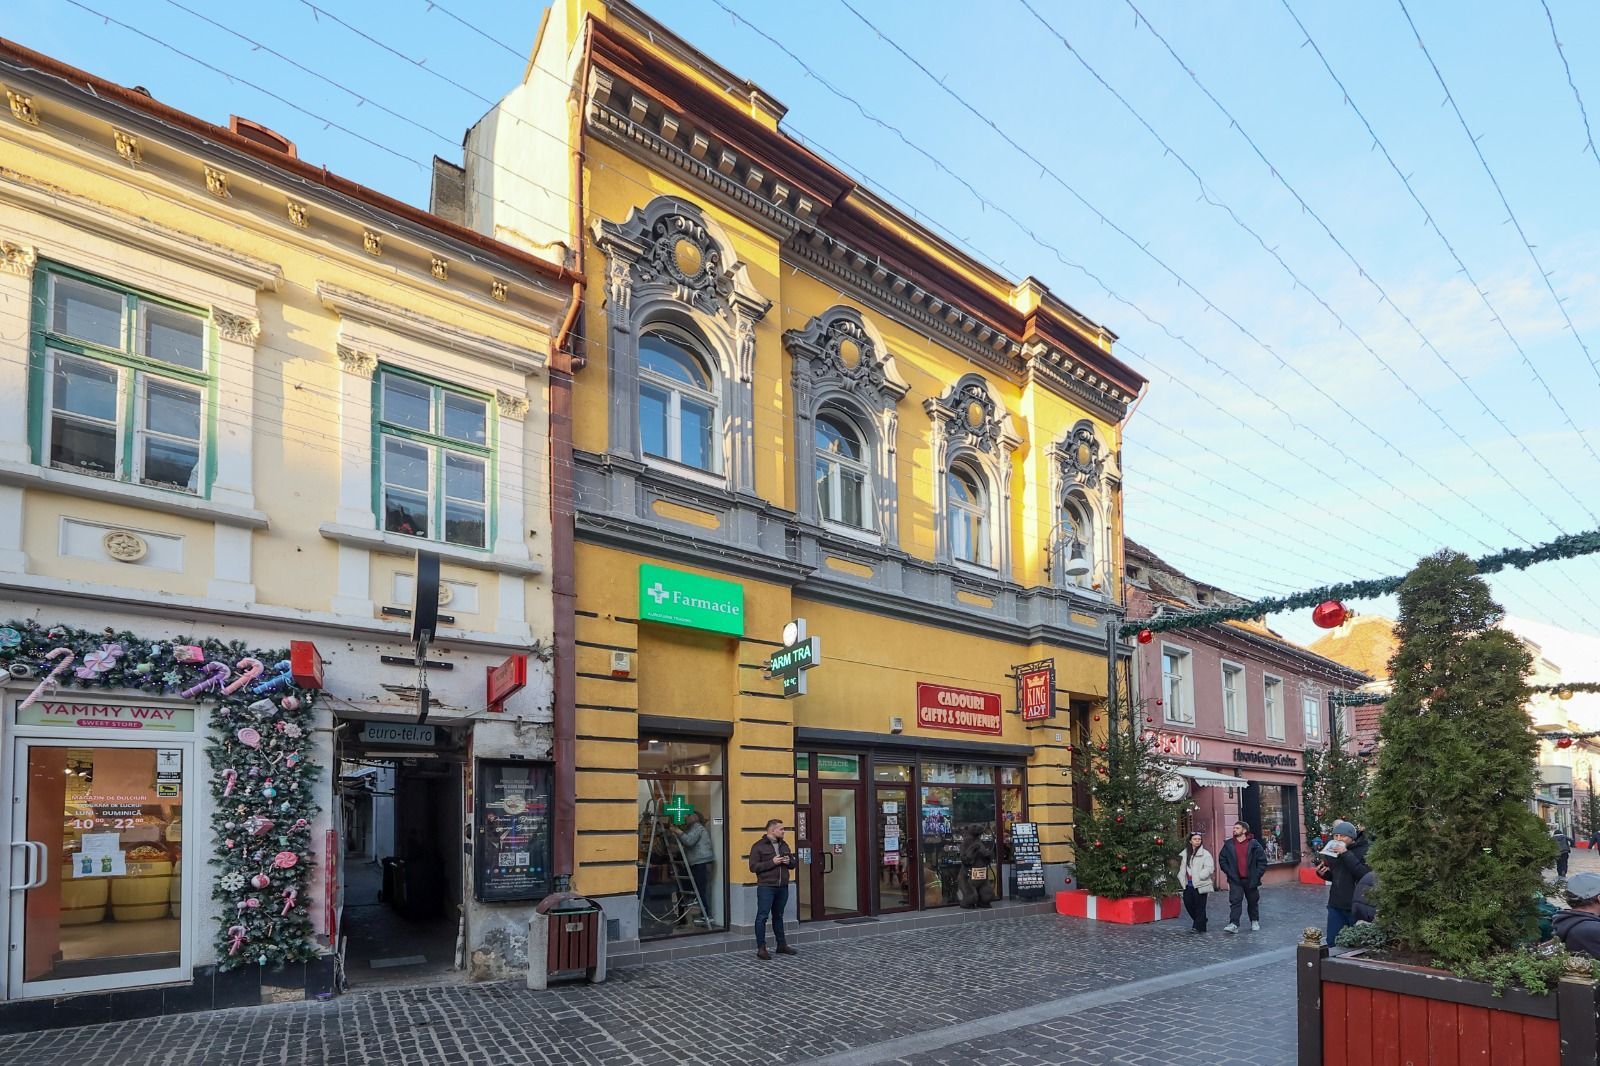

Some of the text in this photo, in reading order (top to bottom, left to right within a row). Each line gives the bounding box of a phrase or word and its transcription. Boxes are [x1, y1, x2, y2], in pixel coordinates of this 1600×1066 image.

[672, 590, 740, 616] Farmacie
[792, 645, 812, 662] TRA
[937, 691, 985, 711] CADOURI
[1027, 686, 1047, 707] KING
[42, 703, 175, 720] YAMMY WAY
[920, 706, 1000, 729] GIFTS & SOUVENIRS
[1028, 703, 1047, 717] ART
[81, 719, 139, 729] SWEET STORE
[368, 726, 432, 742] euro-tel.ro
